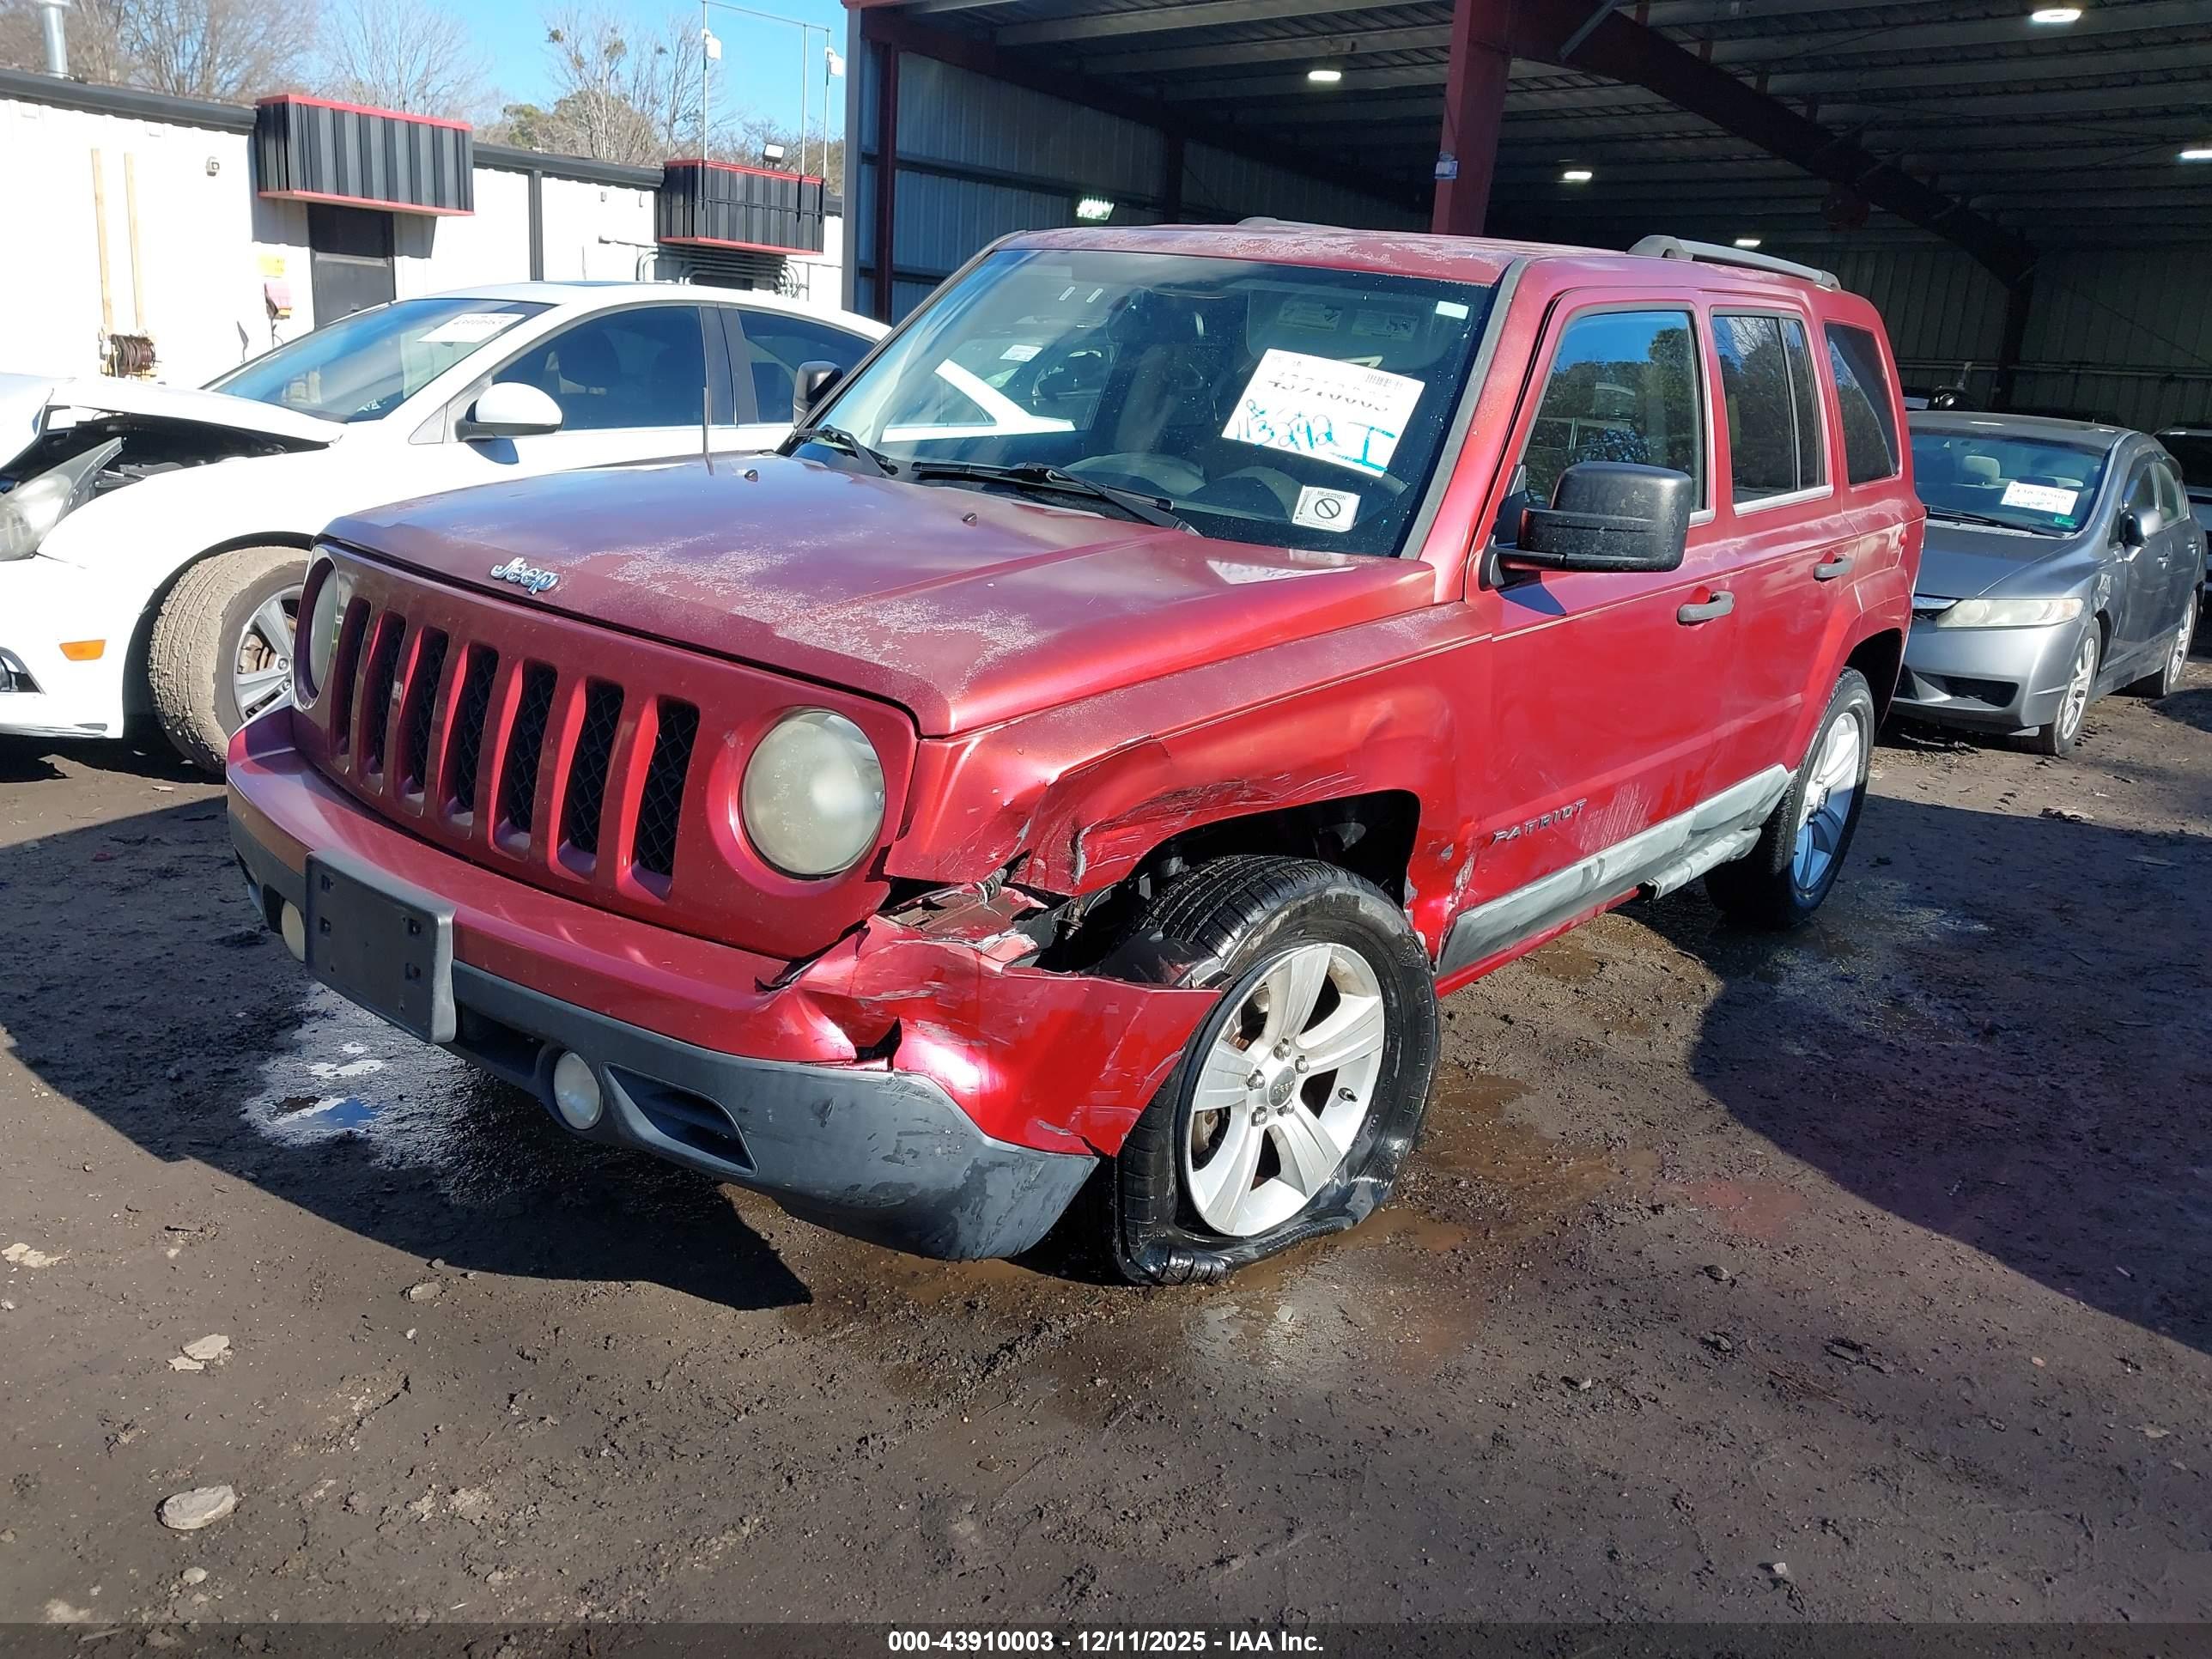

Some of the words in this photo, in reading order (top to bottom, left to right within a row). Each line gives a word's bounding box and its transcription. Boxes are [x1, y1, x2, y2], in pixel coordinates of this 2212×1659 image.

[1317, 490, 1346, 501] REJECTION
[490, 556, 561, 595] Jeep
[1490, 797, 1588, 846] PATRIOT
